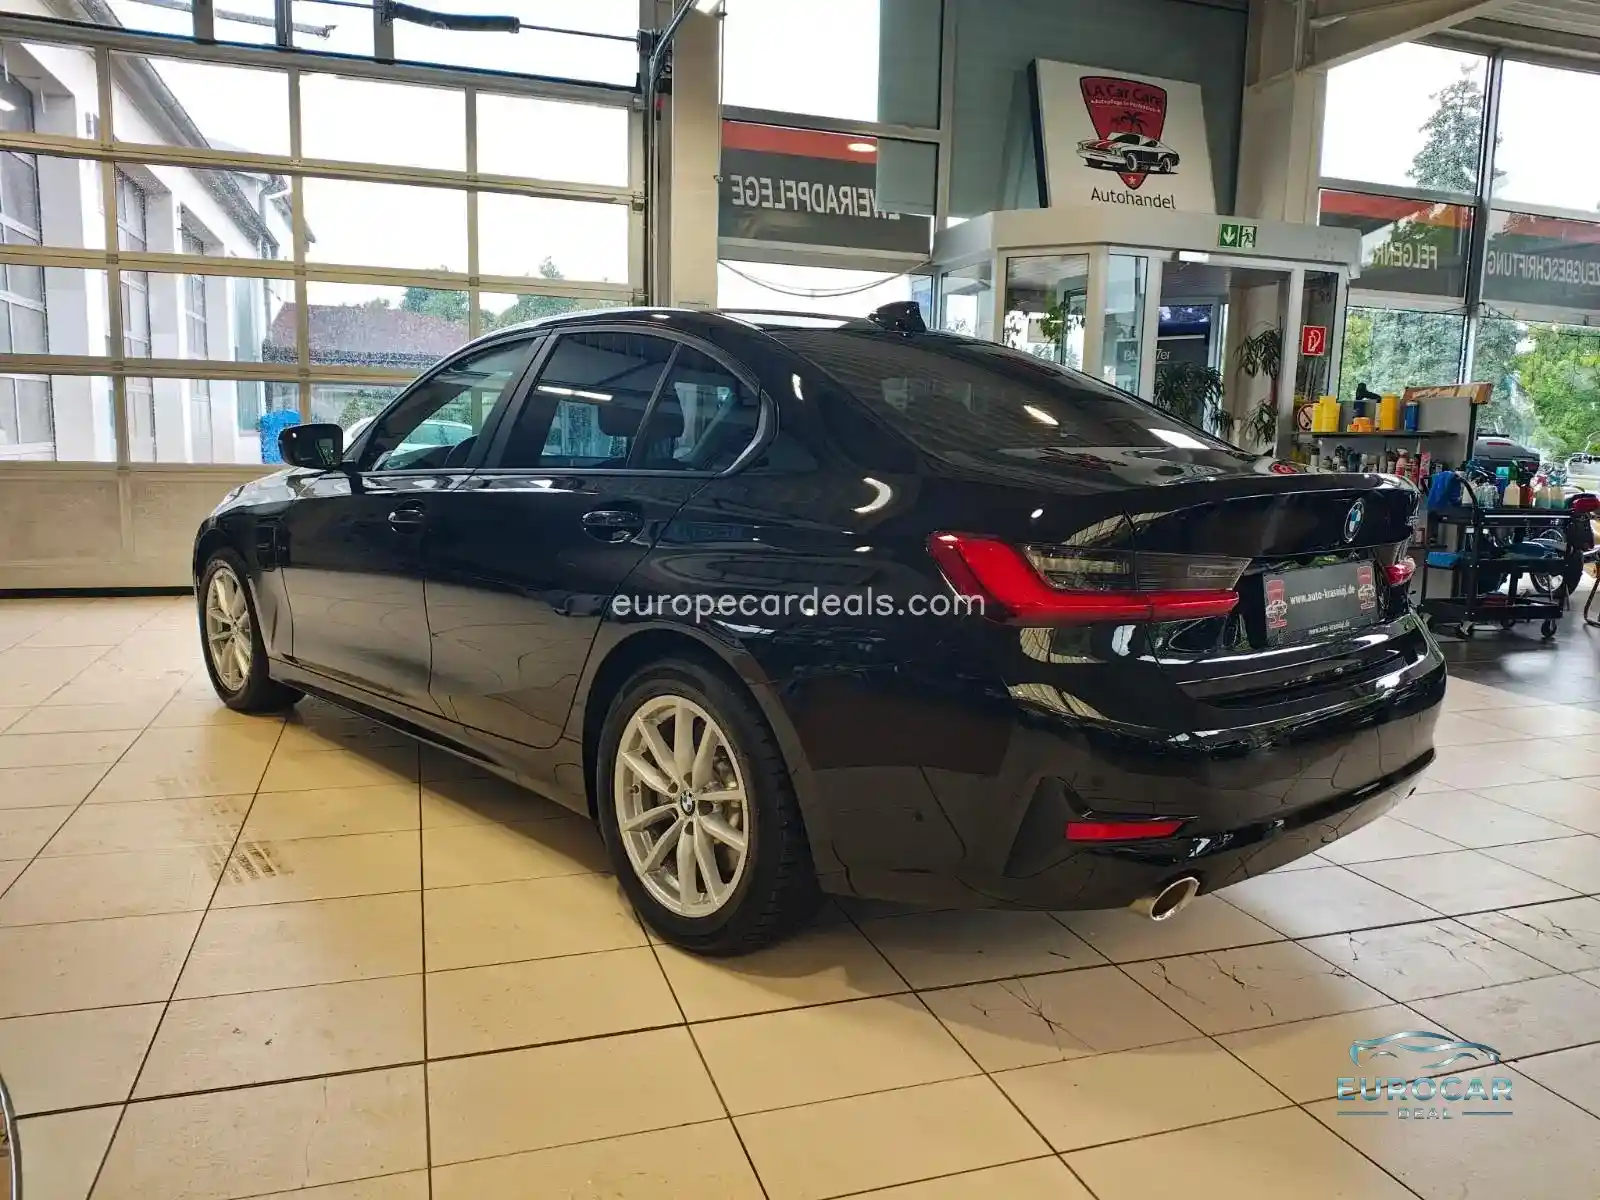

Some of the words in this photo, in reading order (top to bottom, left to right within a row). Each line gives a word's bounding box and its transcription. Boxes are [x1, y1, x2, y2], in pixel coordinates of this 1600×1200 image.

[1106, 84, 1130, 98] Car
[1133, 88, 1161, 105] Care
[1091, 185, 1176, 210] Autohandel
